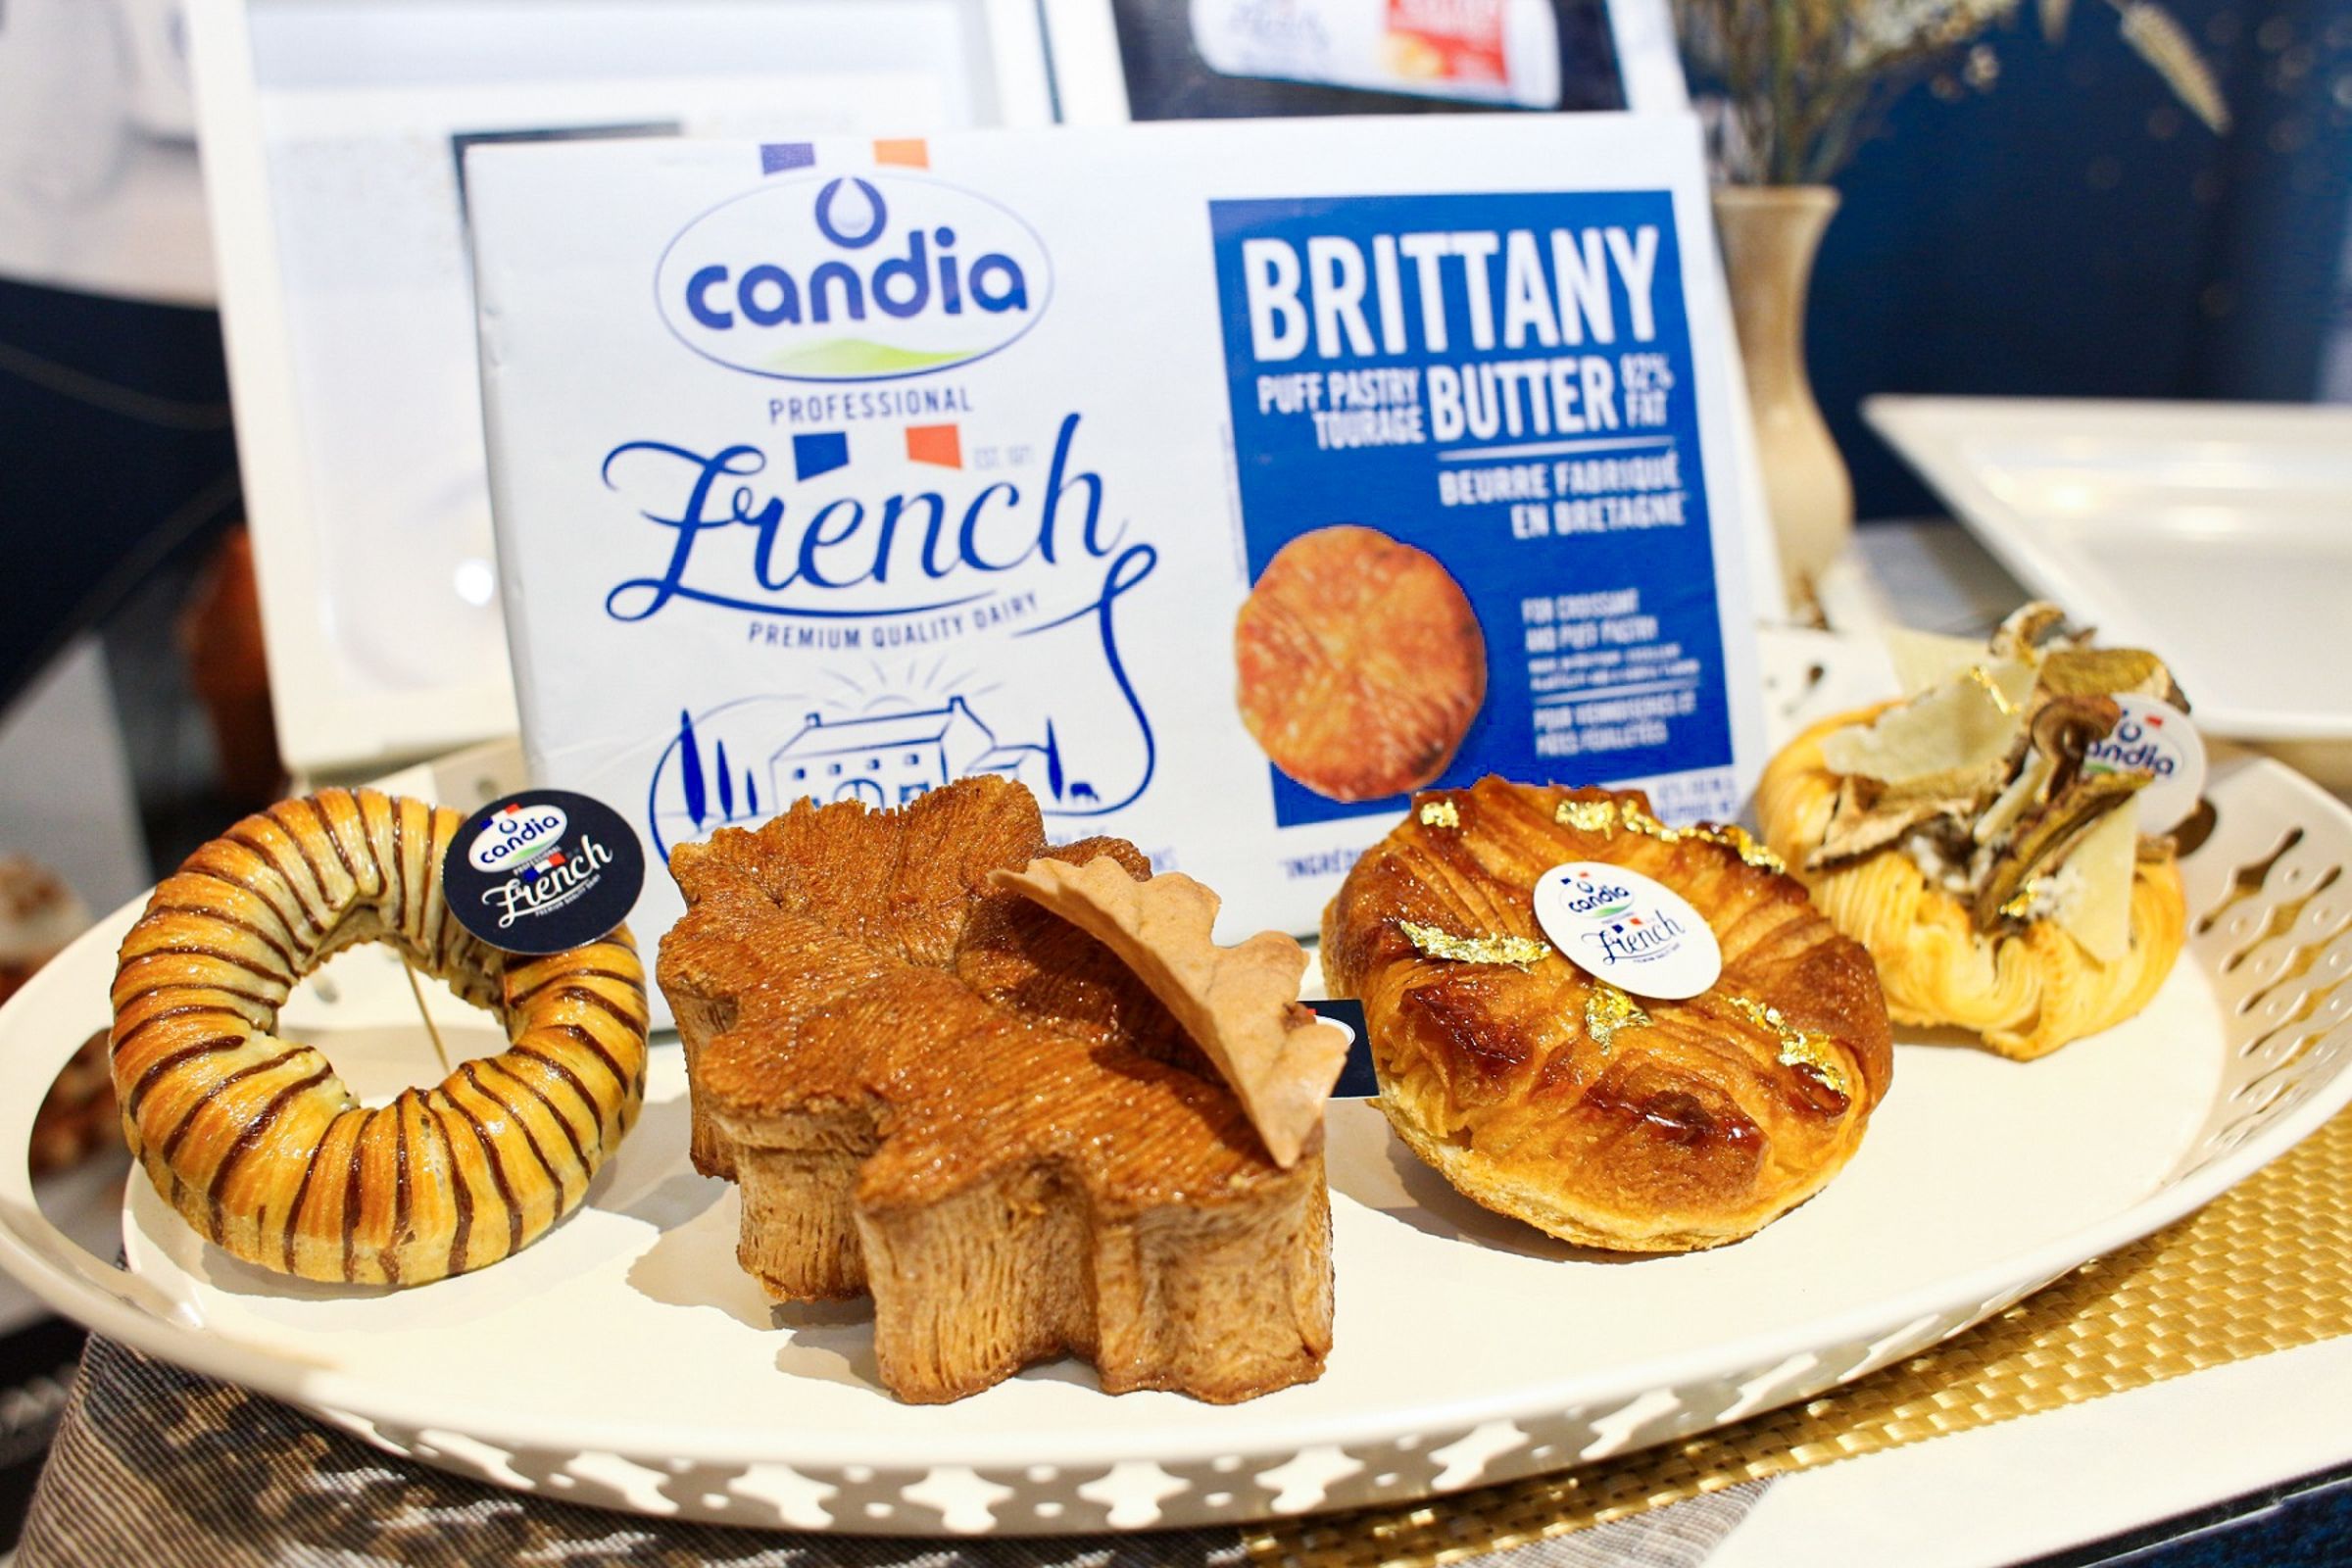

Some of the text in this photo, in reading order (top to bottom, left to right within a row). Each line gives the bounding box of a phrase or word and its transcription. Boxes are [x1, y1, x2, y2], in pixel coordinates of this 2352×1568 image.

[685, 225, 1029, 330] candia
[1242, 224, 1660, 362] BRITTANY
[769, 387, 972, 424] PROFESSIONAL
[1256, 366, 1420, 416] PUFF PASTRY
[1426, 355, 1619, 442] BUTTER
[1311, 404, 1427, 451] TOURAGE
[1438, 463, 1551, 507] BEURRE
[602, 412, 1128, 622] French
[1510, 502, 1550, 539] EN
[748, 592, 1039, 649] PREMIUM QUALITY DAIRY
[480, 814, 560, 865] candia
[481, 834, 613, 929] French
[1568, 884, 1630, 913] candia
[1581, 908, 1686, 965] French
